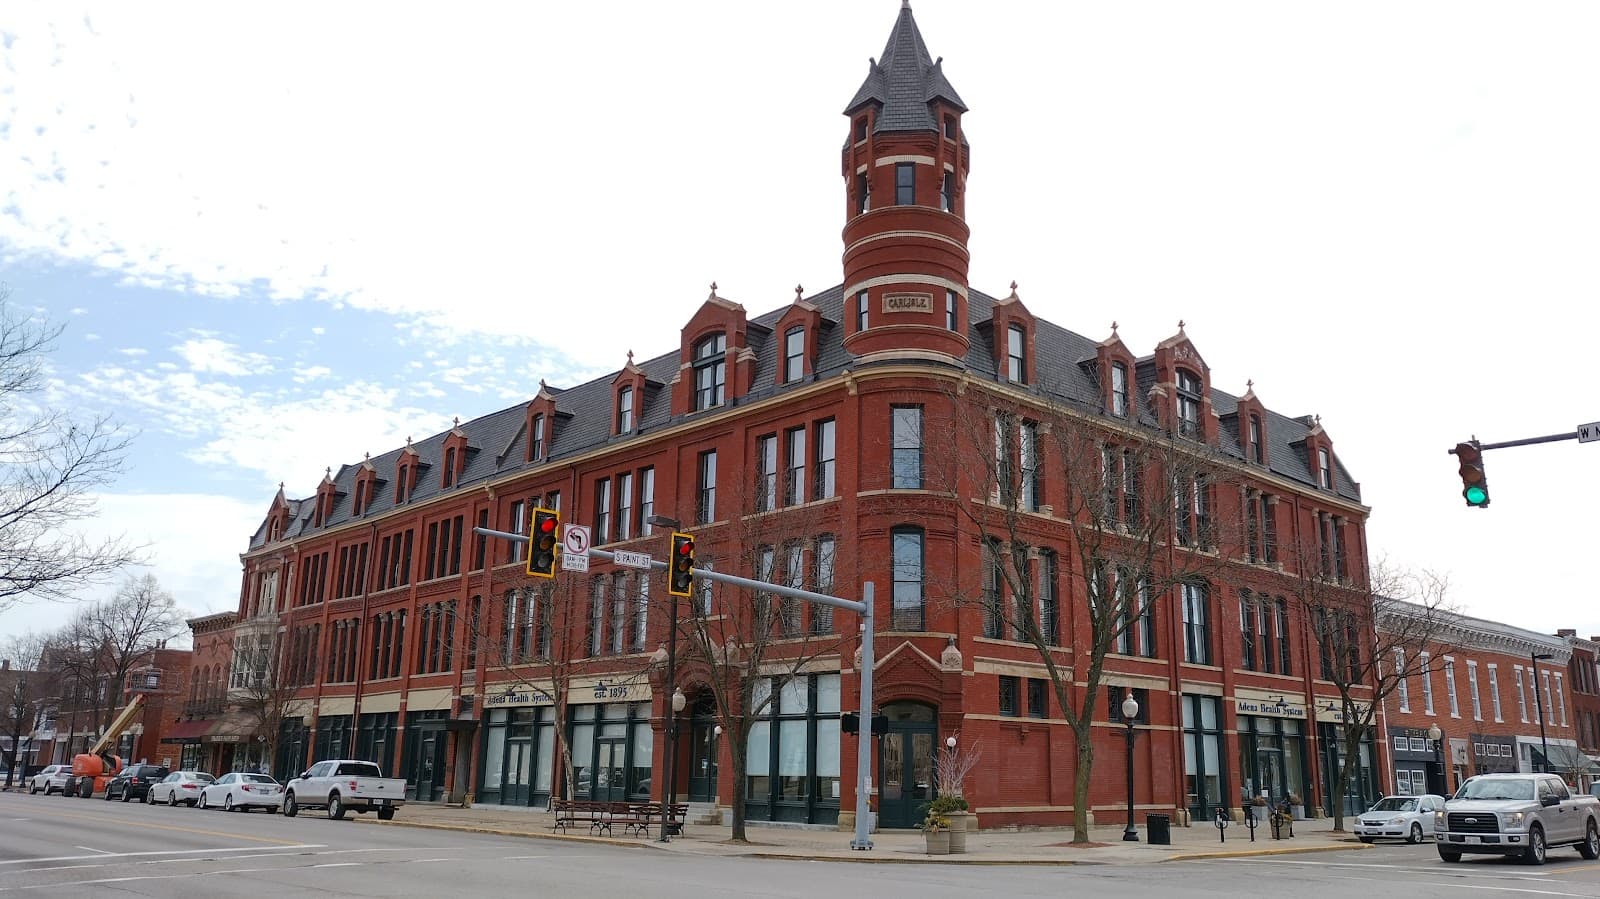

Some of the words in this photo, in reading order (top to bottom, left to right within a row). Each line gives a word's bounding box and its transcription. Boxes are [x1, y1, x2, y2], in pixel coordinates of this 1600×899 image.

[888, 298, 927, 308] CARLISLE
[1580, 427, 1589, 439] W
[616, 553, 621, 562] S
[622, 554, 640, 564] PAINT
[641, 557, 650, 566] ST
[609, 687, 627, 698] 1895
[1238, 702, 1258, 712] Adena
[1260, 703, 1281, 714] Health
[1282, 705, 1303, 717] System
